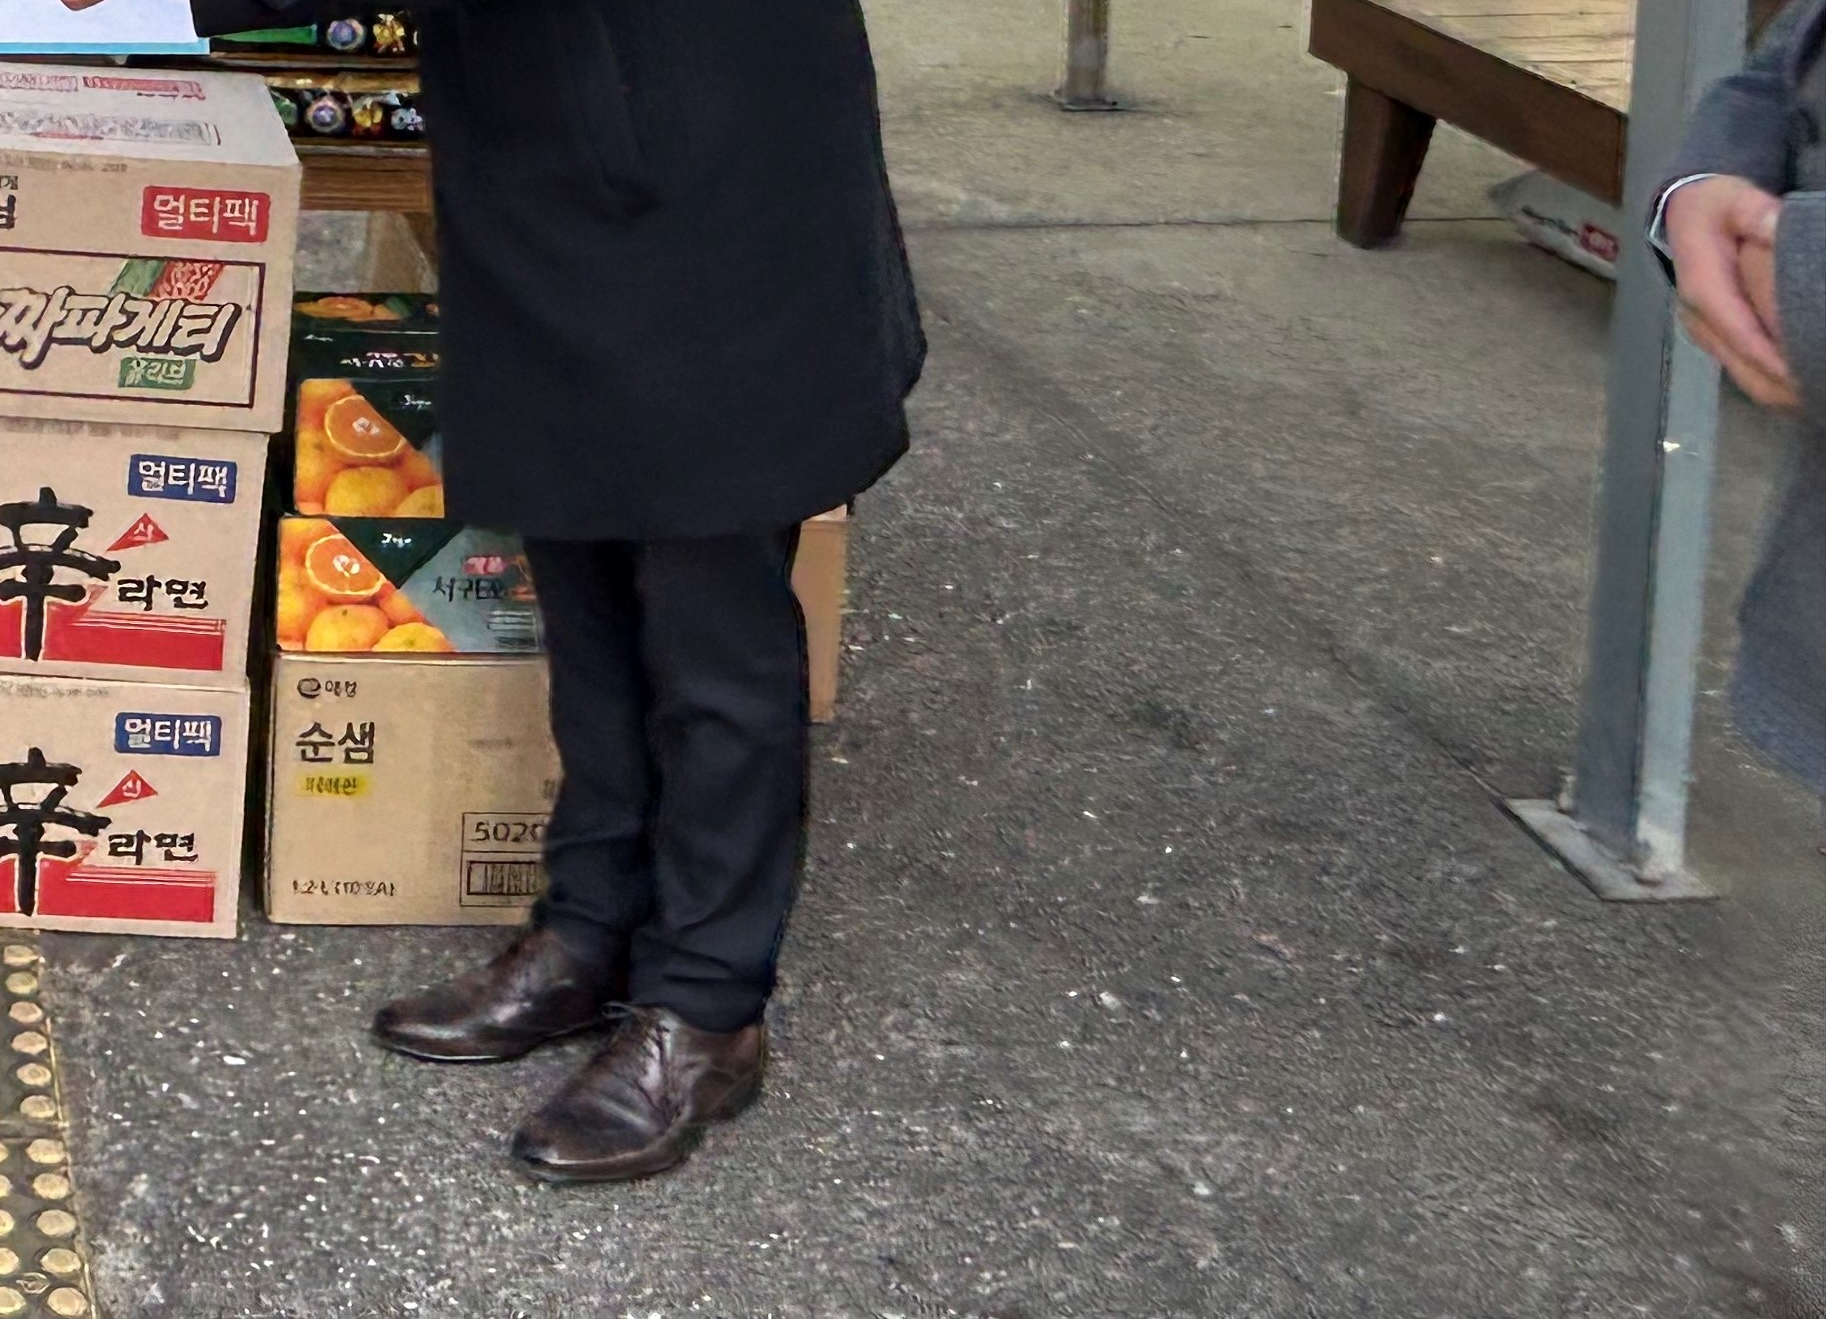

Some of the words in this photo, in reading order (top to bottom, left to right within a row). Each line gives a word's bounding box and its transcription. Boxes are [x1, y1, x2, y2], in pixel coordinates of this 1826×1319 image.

[153, 194, 259, 236] 멀티팩
[138, 460, 228, 497] 멀티팩
[117, 576, 209, 611] 라면
[124, 719, 213, 752] 멀티팩
[295, 721, 374, 764] 순샘
[108, 829, 200, 865] 라면
